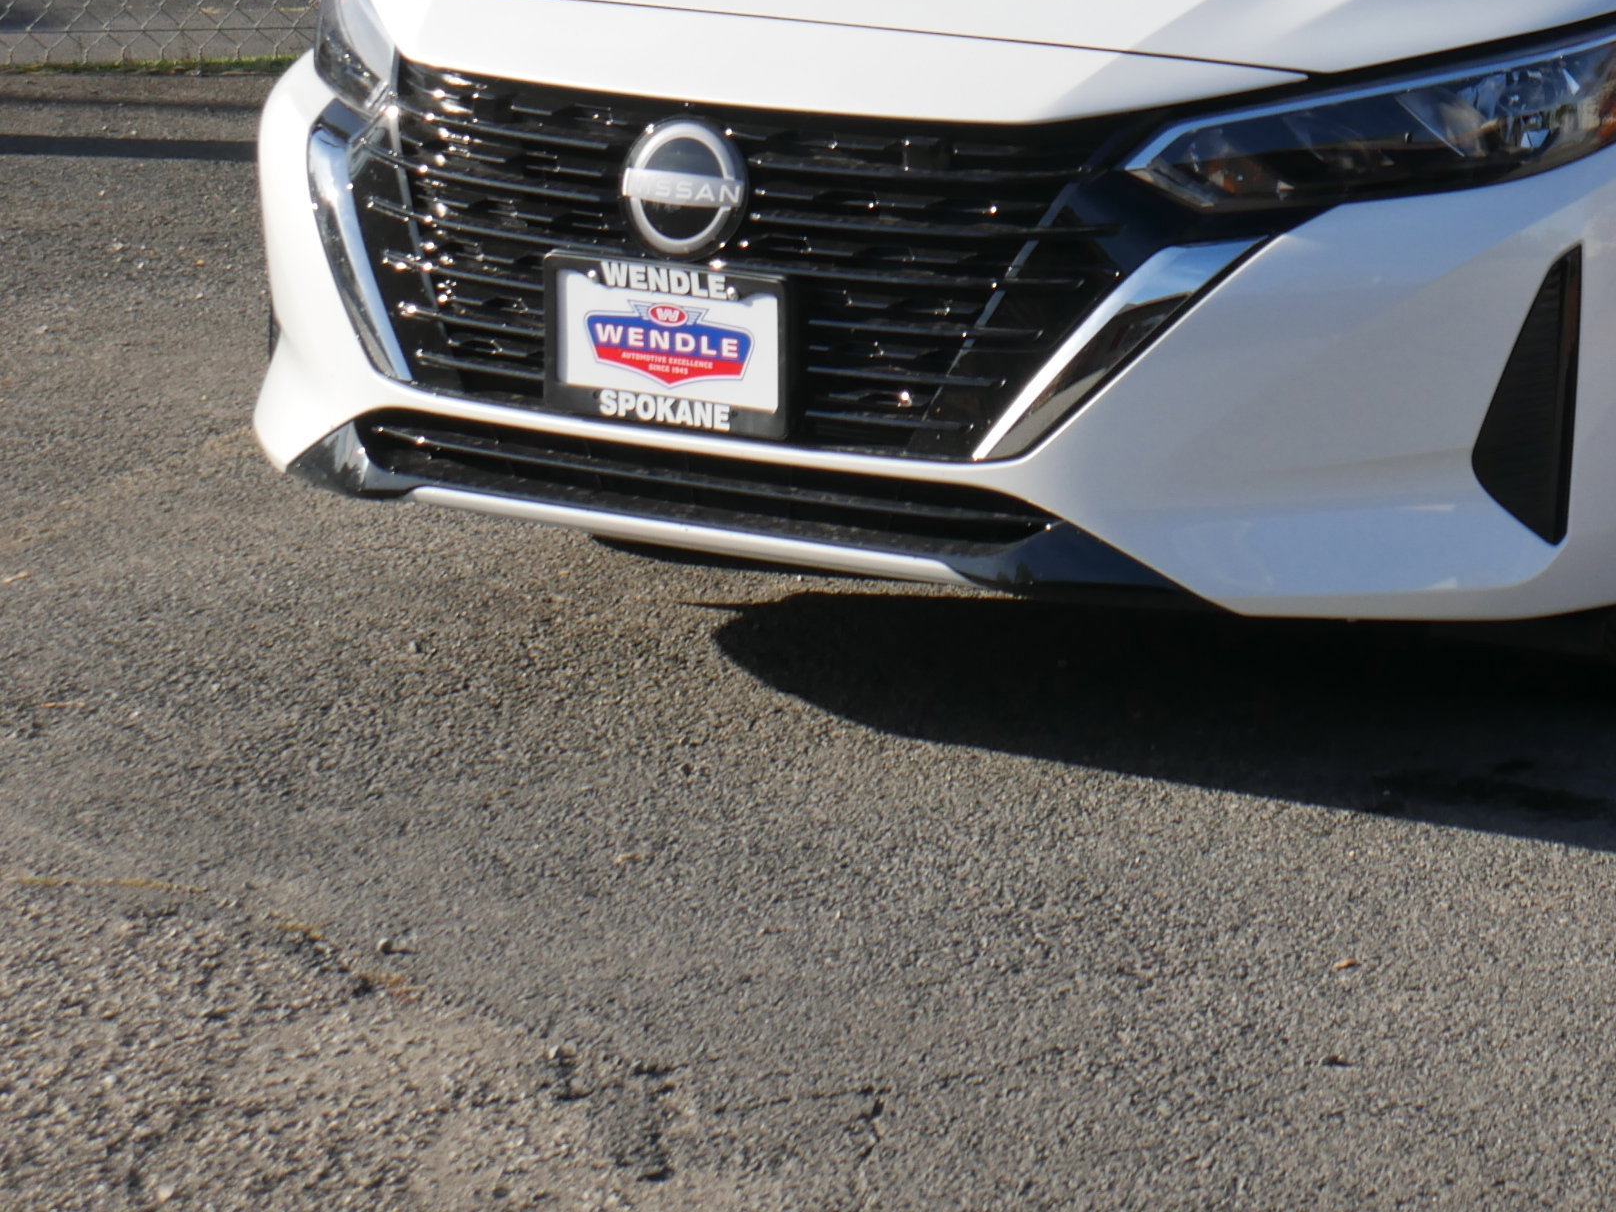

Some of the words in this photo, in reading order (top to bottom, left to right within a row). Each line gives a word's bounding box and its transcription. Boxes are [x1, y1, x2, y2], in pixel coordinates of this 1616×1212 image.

[601, 260, 728, 300] WENDLE
[594, 322, 739, 358] WENDLE
[621, 351, 667, 364] AUTOMOTIVE
[668, 356, 714, 369] EXCELLENCE
[648, 362, 670, 374] SINCE
[599, 388, 731, 431] SPOKANE
